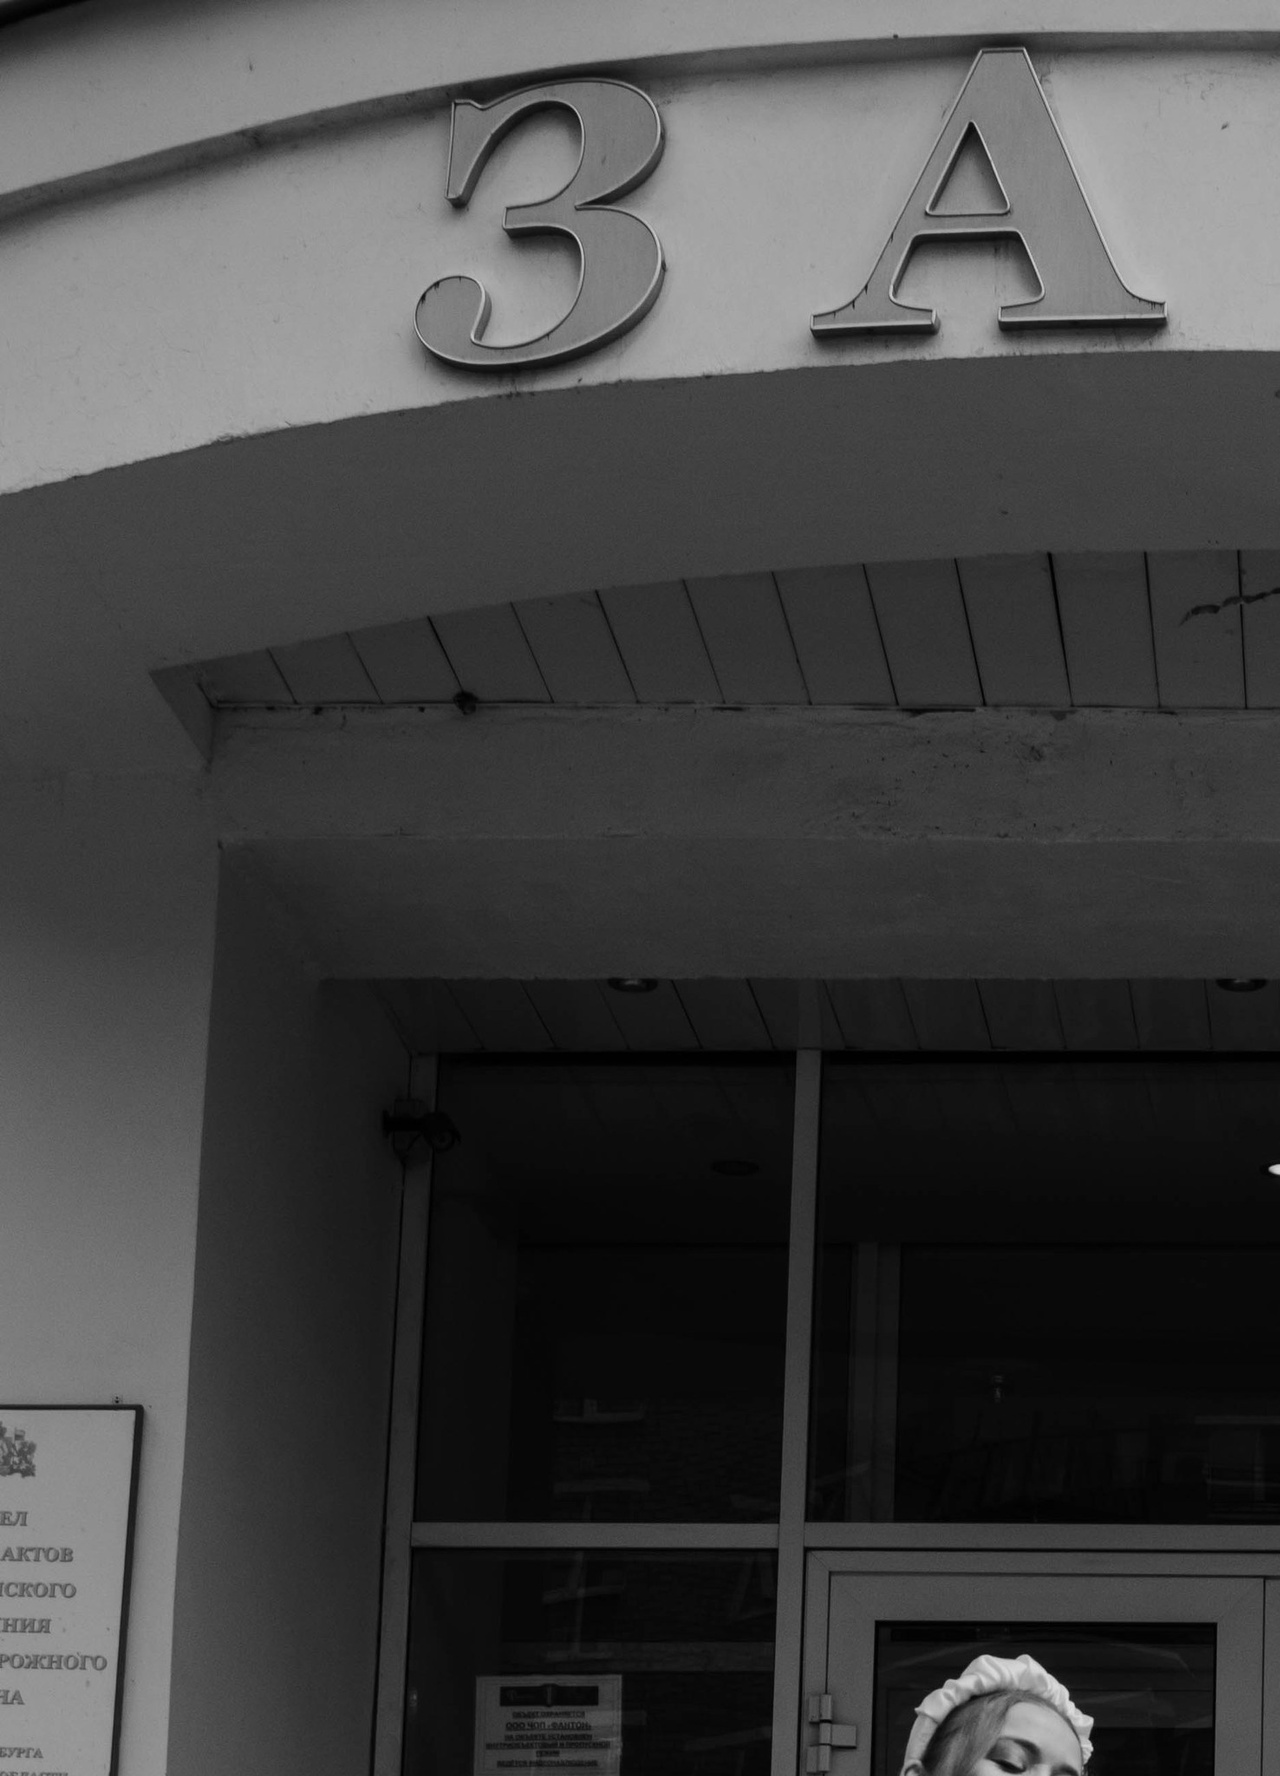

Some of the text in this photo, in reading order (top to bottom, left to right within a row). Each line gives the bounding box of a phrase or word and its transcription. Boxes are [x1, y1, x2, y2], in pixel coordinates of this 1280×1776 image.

[0, 1546, 75, 1563] АКТОВ
[0, 1582, 77, 1598] СКОГО
[0, 1617, 51, 1634] НИЯ
[0, 1653, 107, 1671] РОЖНОГО
